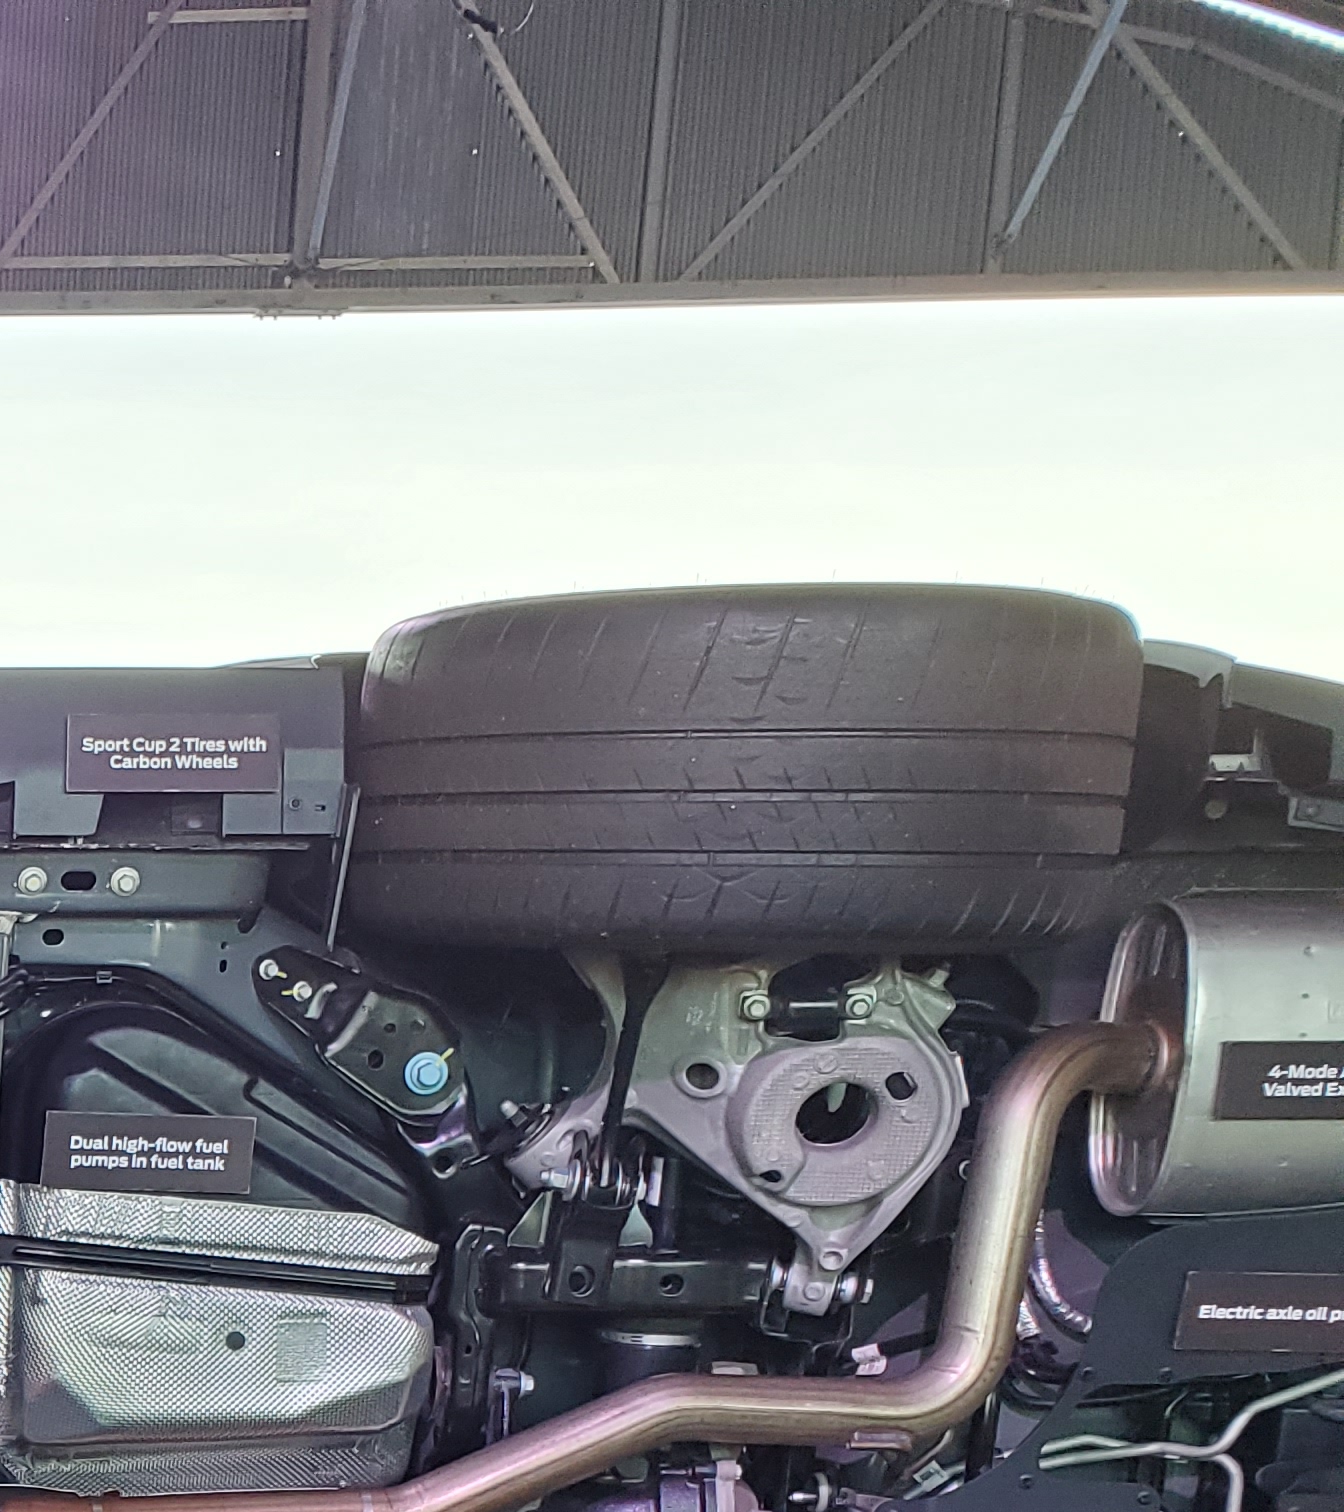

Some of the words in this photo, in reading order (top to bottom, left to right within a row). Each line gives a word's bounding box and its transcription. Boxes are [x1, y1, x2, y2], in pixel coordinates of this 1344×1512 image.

[82, 737, 130, 754] Sport
[133, 737, 166, 754] Cup
[169, 738, 180, 751] 2
[183, 738, 225, 752] Tires
[228, 737, 266, 752] with
[110, 754, 172, 768] Carbon
[175, 754, 238, 768] Wheels
[1268, 1064, 1338, 1078] 4-Mode
[1263, 1082, 1324, 1096] Valved
[70, 1136, 108, 1150] Dual
[112, 1136, 192, 1153] high-flow
[195, 1139, 228, 1153] fuel
[71, 1155, 128, 1169] pumps
[132, 1154, 147, 1168] in
[150, 1154, 183, 1169] fuel
[187, 1156, 224, 1170] tank
[1198, 1305, 1265, 1319] Electric
[1264, 1306, 1303, 1320] axle
[1305, 1307, 1328, 1320] oil
